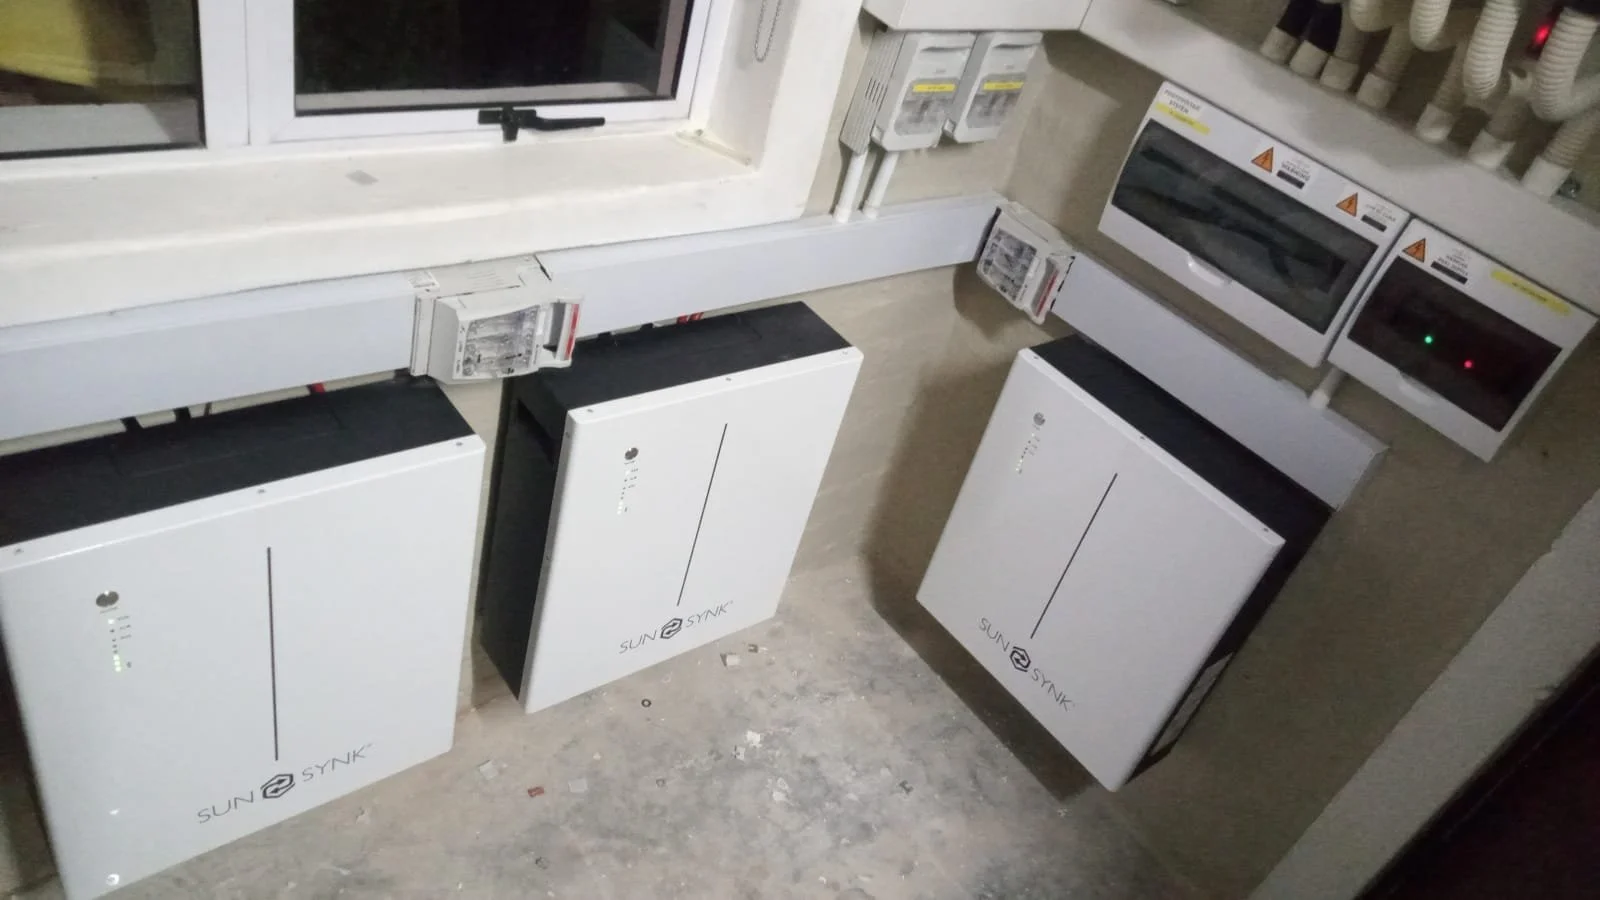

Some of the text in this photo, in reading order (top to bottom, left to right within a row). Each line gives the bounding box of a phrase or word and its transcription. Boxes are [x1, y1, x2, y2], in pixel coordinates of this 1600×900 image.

[619, 603, 728, 655] SUN SYNK
[977, 616, 1073, 712] SUN SYNK
[196, 745, 367, 825] SUN SYNK
